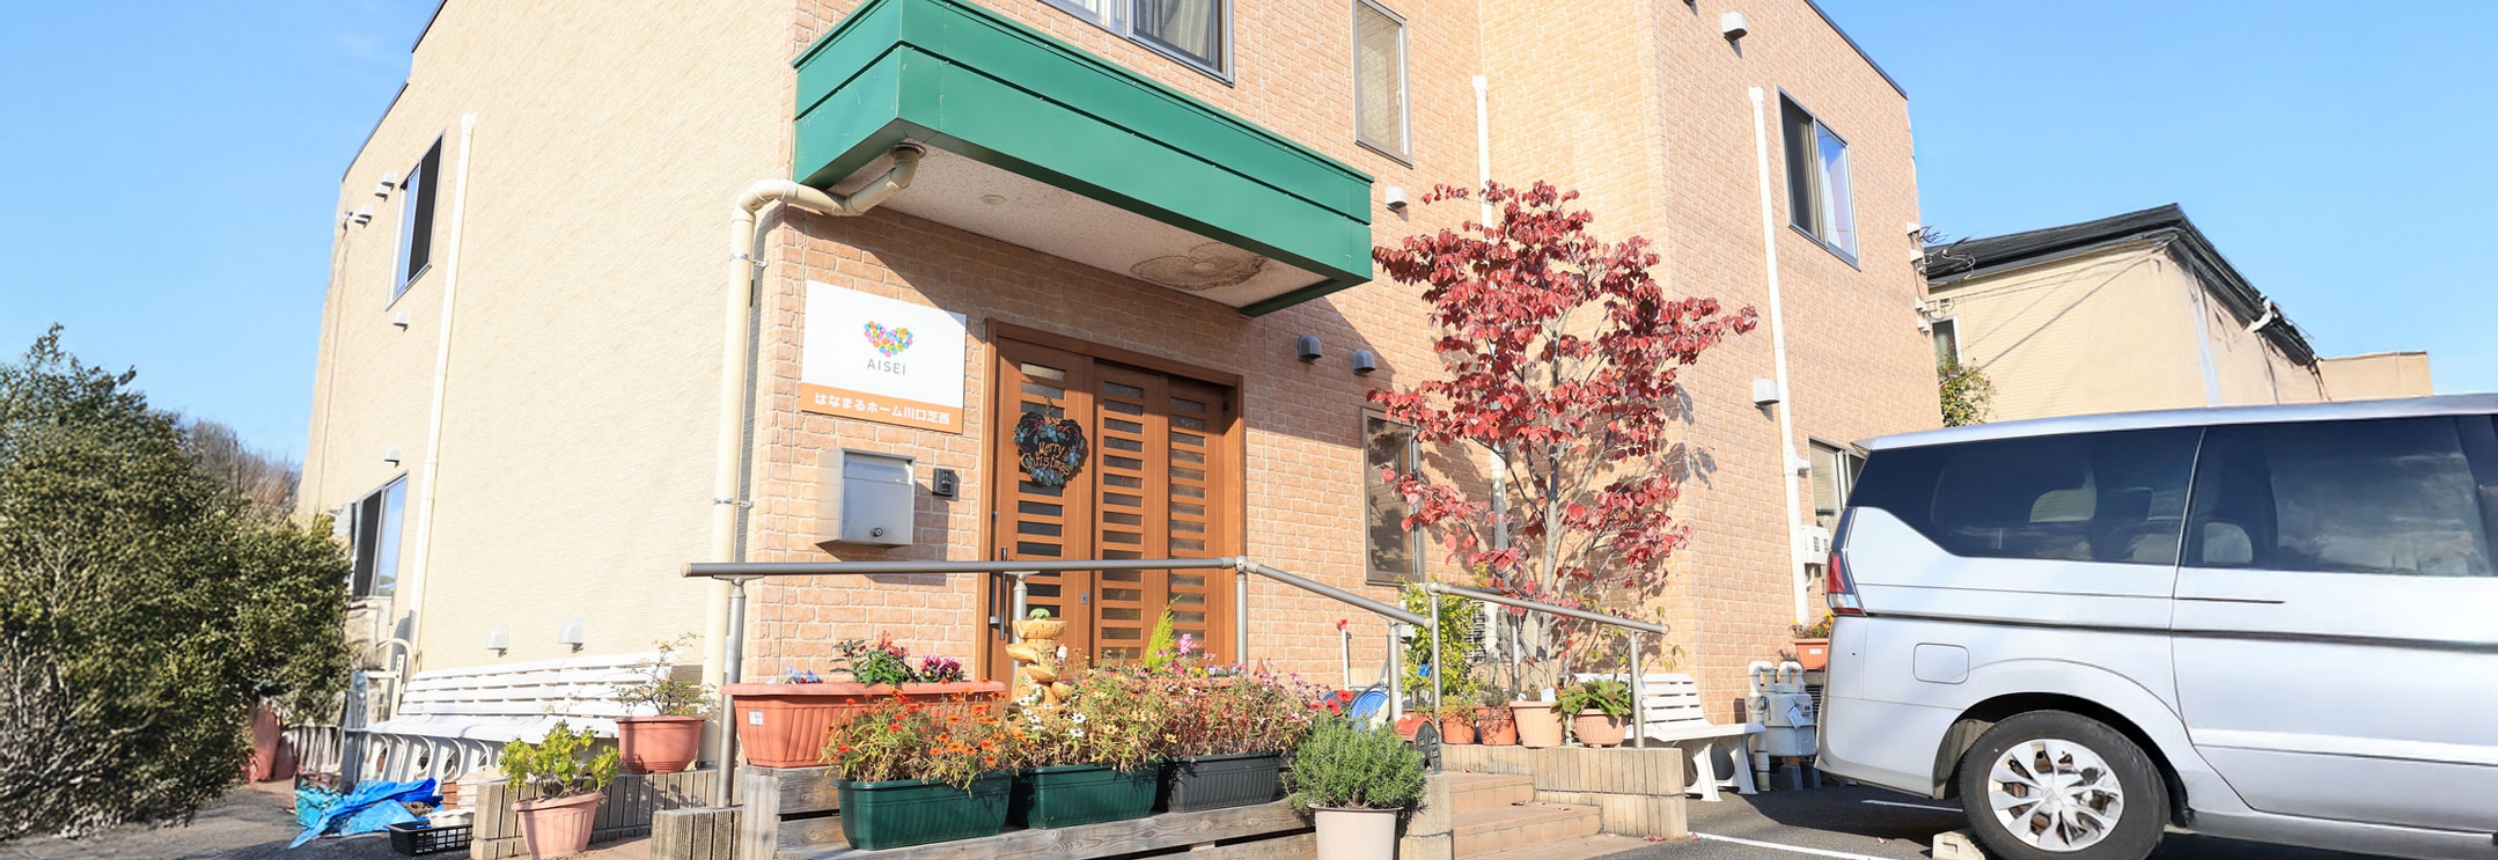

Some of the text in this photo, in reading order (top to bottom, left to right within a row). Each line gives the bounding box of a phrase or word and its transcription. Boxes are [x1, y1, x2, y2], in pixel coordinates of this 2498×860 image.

[867, 358, 906, 375] AISEI
[815, 393, 950, 425] はなまるホーム川口芝西
[1036, 441, 1065, 458] Merry
[1020, 452, 1070, 476] Christmas
